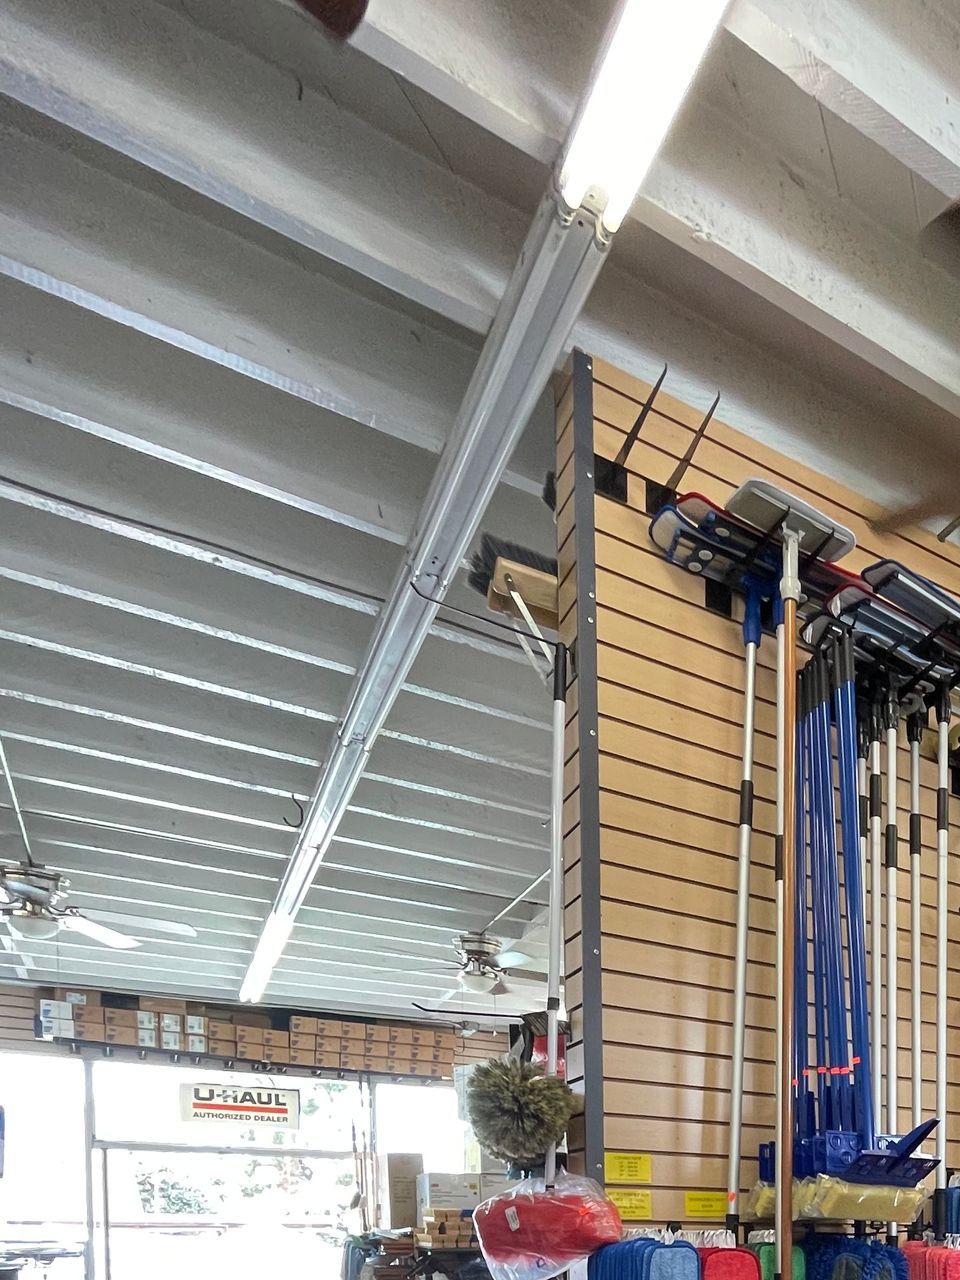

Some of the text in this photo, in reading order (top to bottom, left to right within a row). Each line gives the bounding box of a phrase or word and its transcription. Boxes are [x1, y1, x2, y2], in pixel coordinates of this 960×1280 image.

[193, 1087, 286, 1106] U-HAUL
[192, 1111, 289, 1123] AUTHORIZED DEALER
